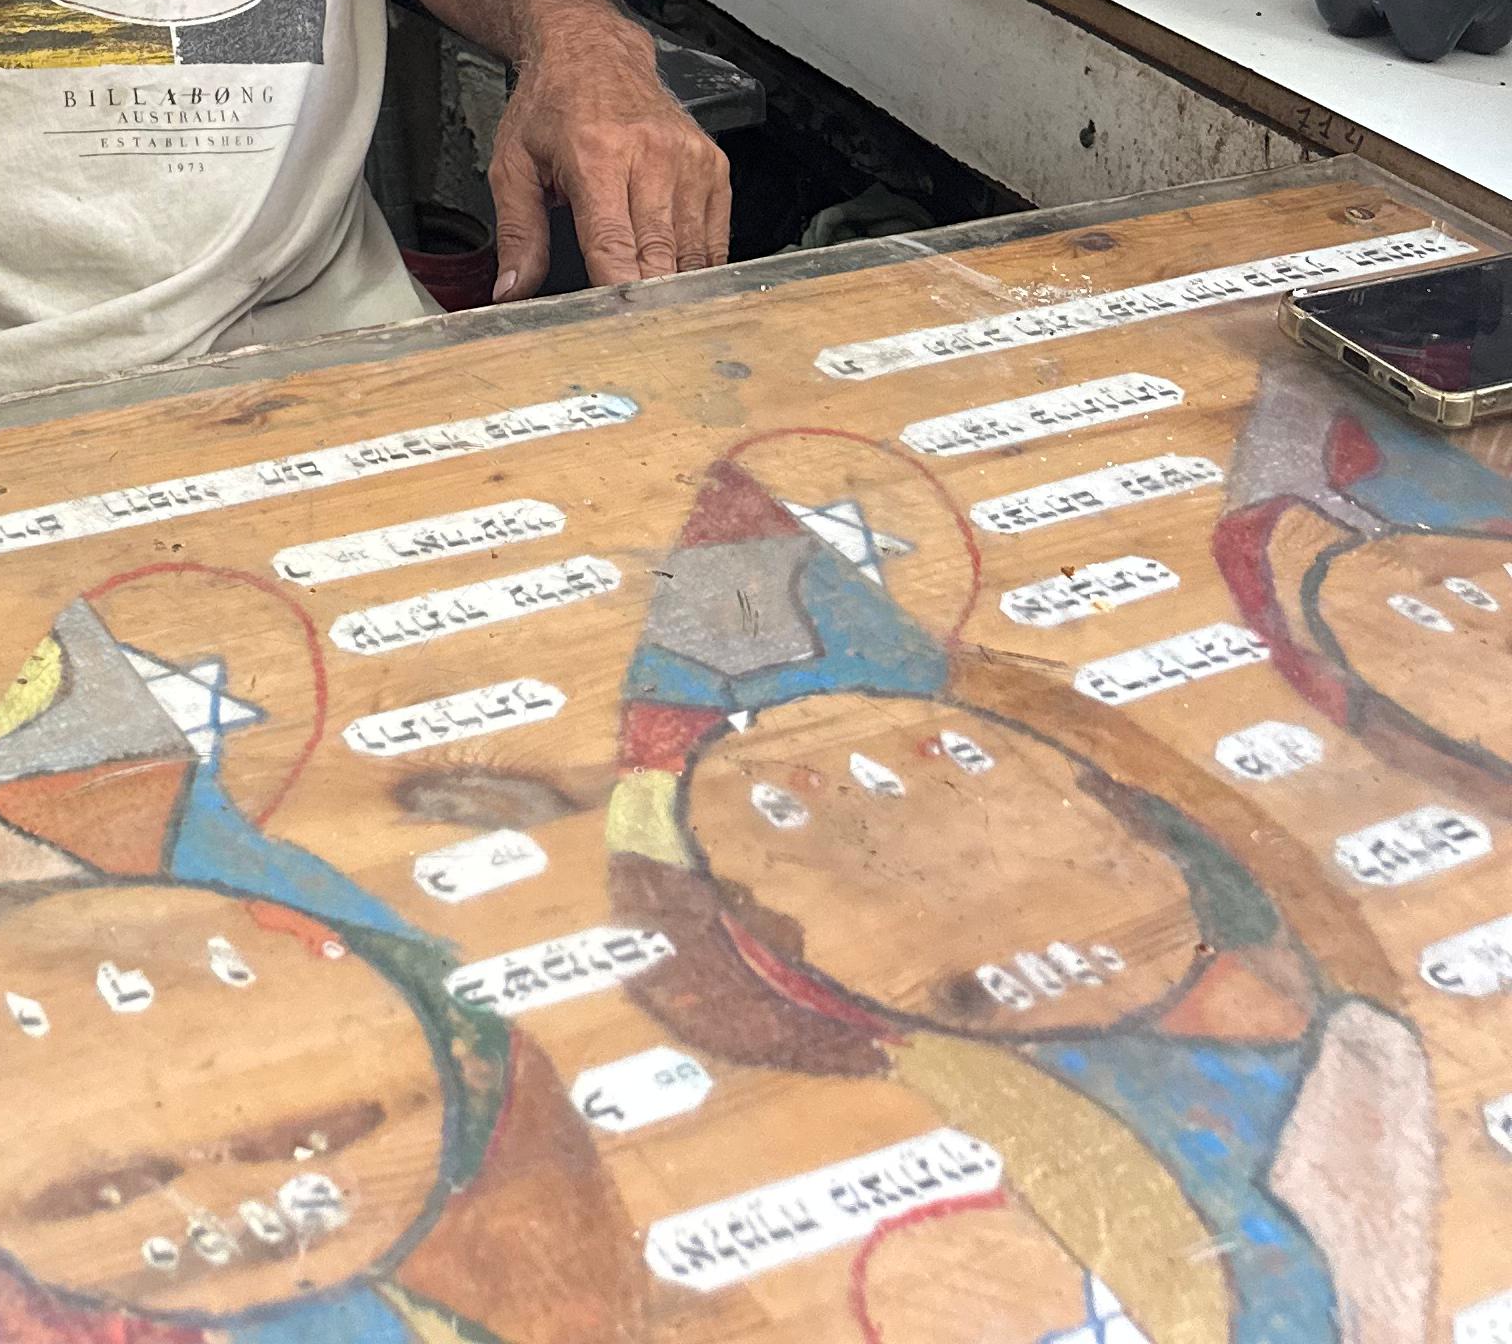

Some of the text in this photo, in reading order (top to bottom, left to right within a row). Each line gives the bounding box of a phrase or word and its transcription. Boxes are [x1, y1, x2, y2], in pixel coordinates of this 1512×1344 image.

[118, 111, 241, 124] AUSTRALIA
[101, 135, 255, 148] ESTABLISHED
[168, 163, 205, 173] 1973
